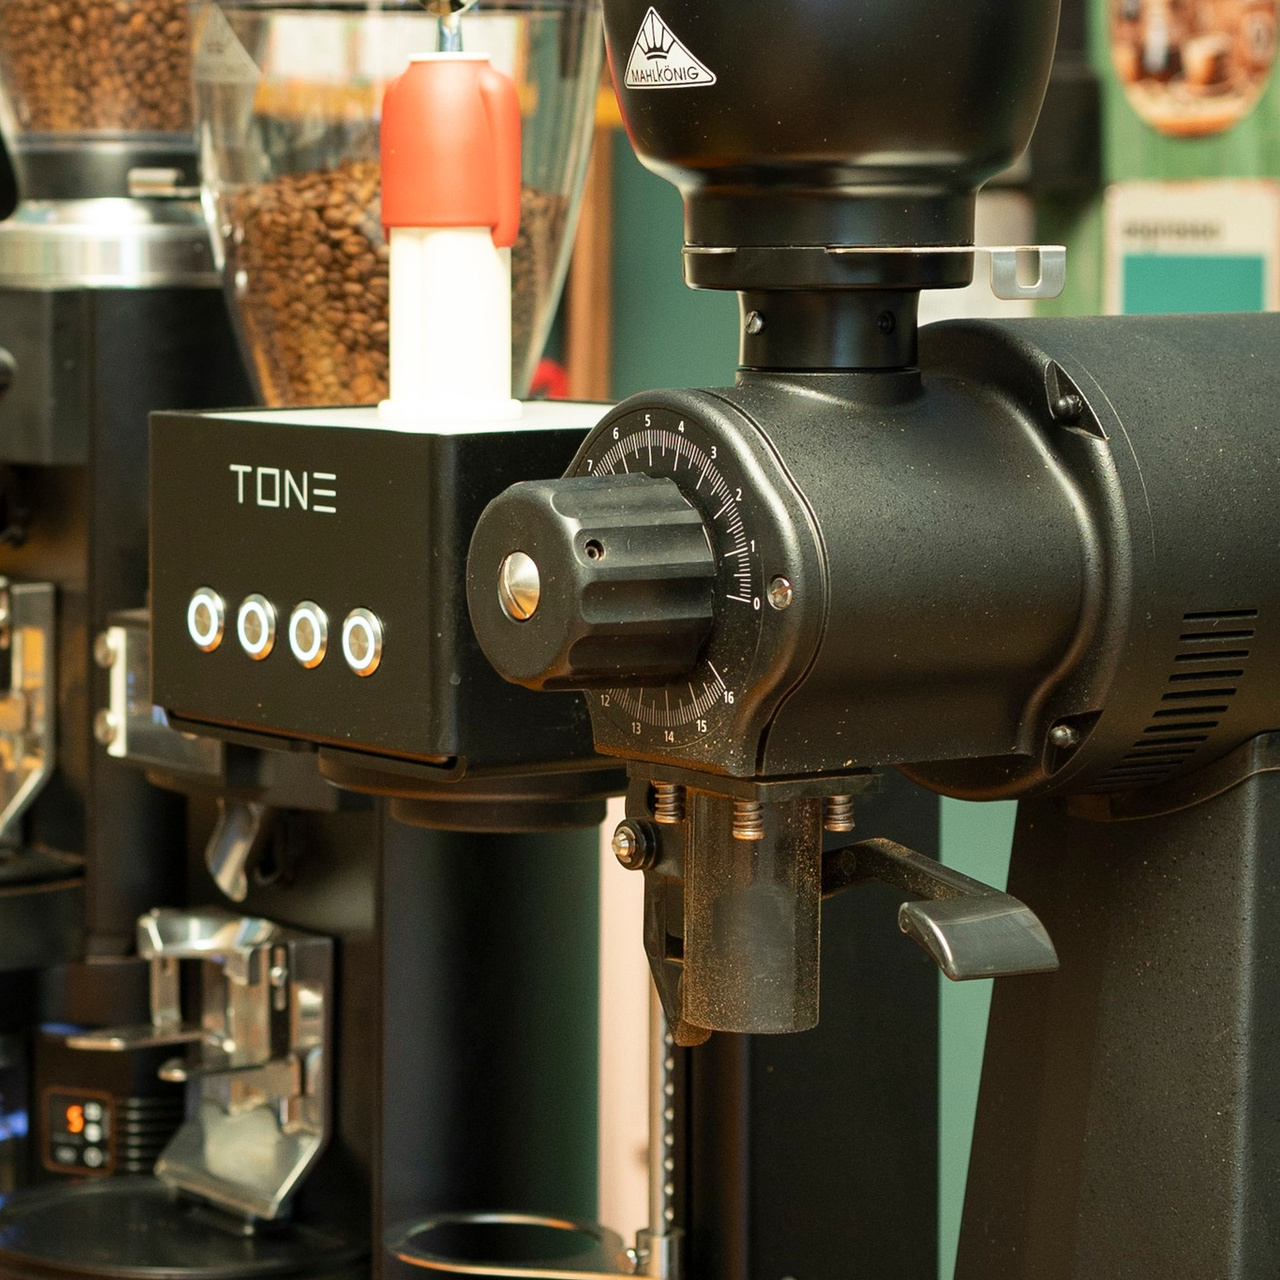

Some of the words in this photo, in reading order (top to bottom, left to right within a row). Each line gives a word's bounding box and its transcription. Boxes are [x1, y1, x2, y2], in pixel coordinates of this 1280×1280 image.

[631, 61, 699, 83] MAHLKÖNIG
[644, 413, 651, 428] 5
[677, 420, 685, 434] 4
[612, 426, 620, 440] 6
[710, 445, 718, 460] 3
[586, 459, 594, 472] 7
[229, 463, 337, 514] TONE
[734, 487, 743, 502] 2
[749, 539, 756, 553] 1
[753, 596, 761, 611] 0
[600, 693, 611, 708] 12
[723, 690, 735, 705] 16
[631, 721, 642, 736] 13
[696, 719, 708, 734] 15
[664, 730, 675, 744] 14
